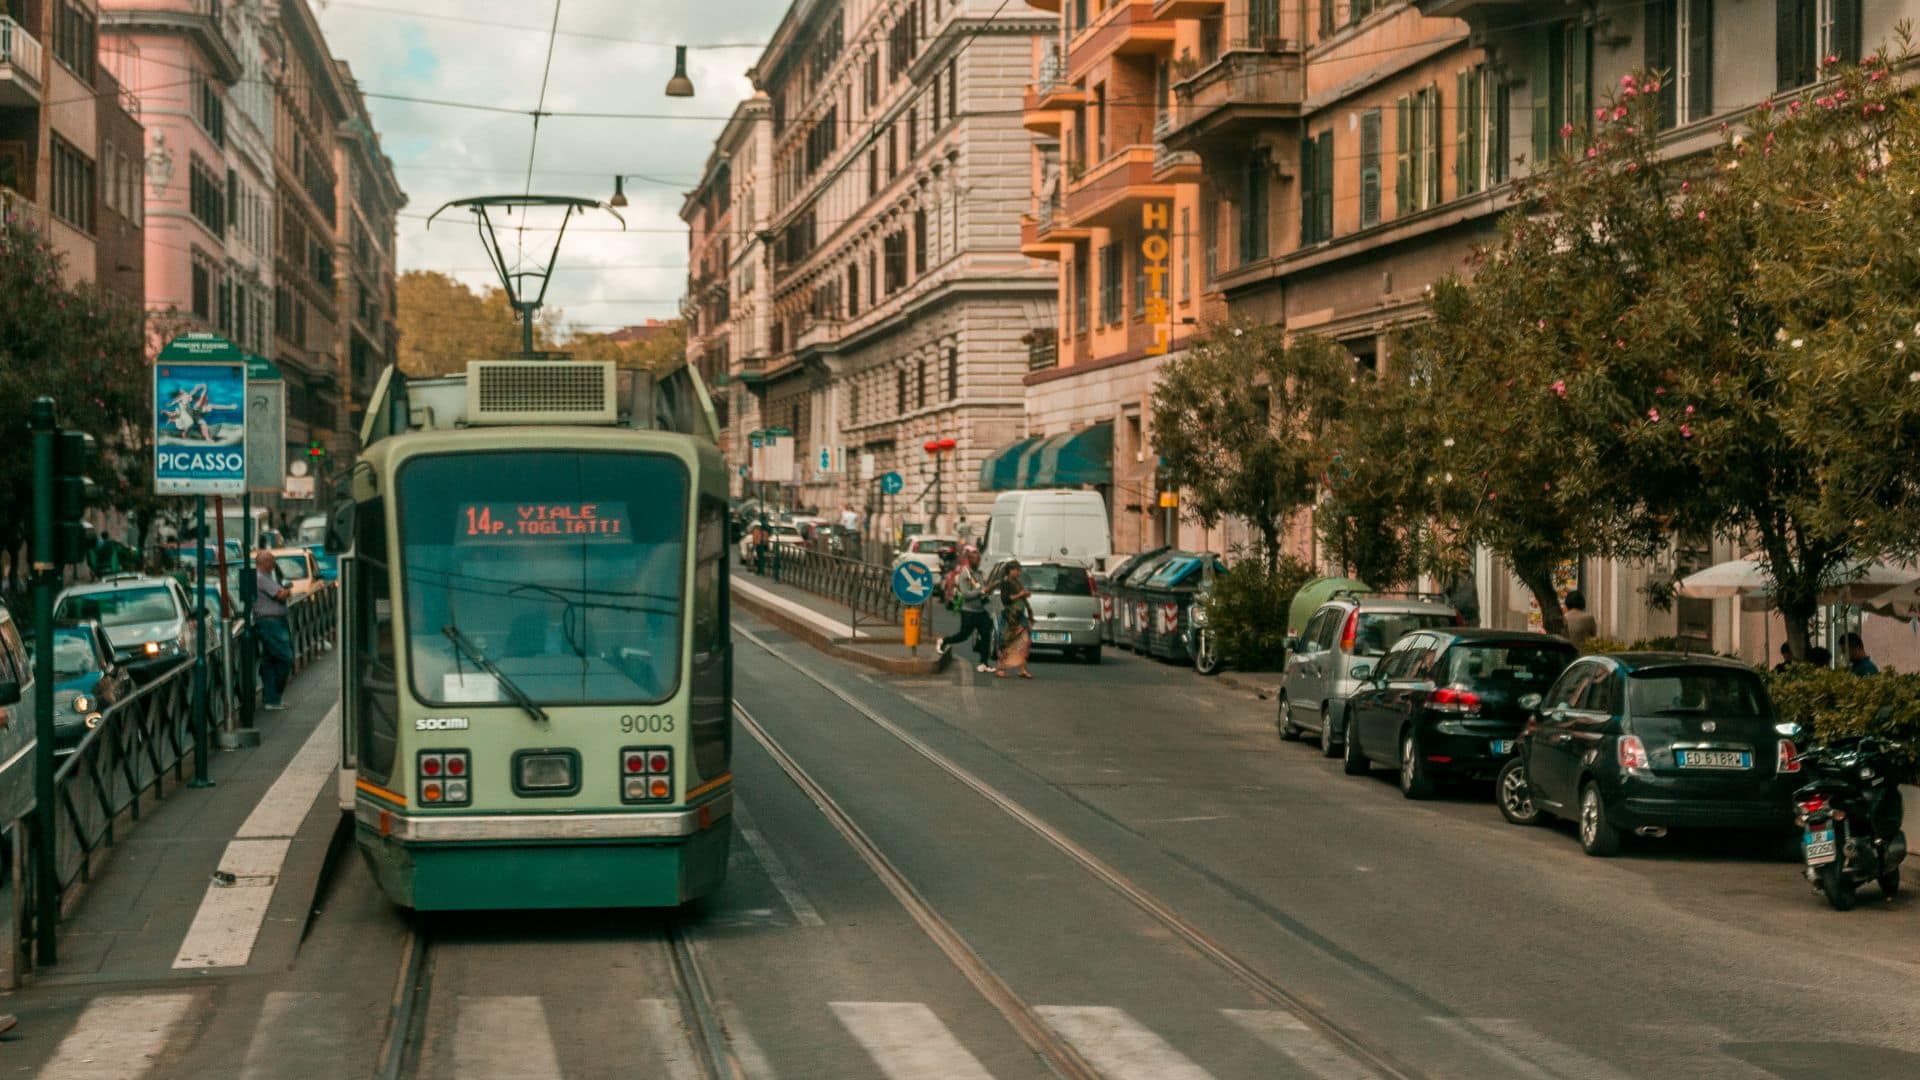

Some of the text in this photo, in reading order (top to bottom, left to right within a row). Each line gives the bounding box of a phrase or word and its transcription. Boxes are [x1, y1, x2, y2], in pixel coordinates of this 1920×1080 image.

[158, 453, 243, 471] PICASSO
[466, 506, 491, 535] 14
[517, 504, 598, 519] VIALE
[517, 519, 621, 535] TOGLIATTI
[620, 714, 675, 733] 9003
